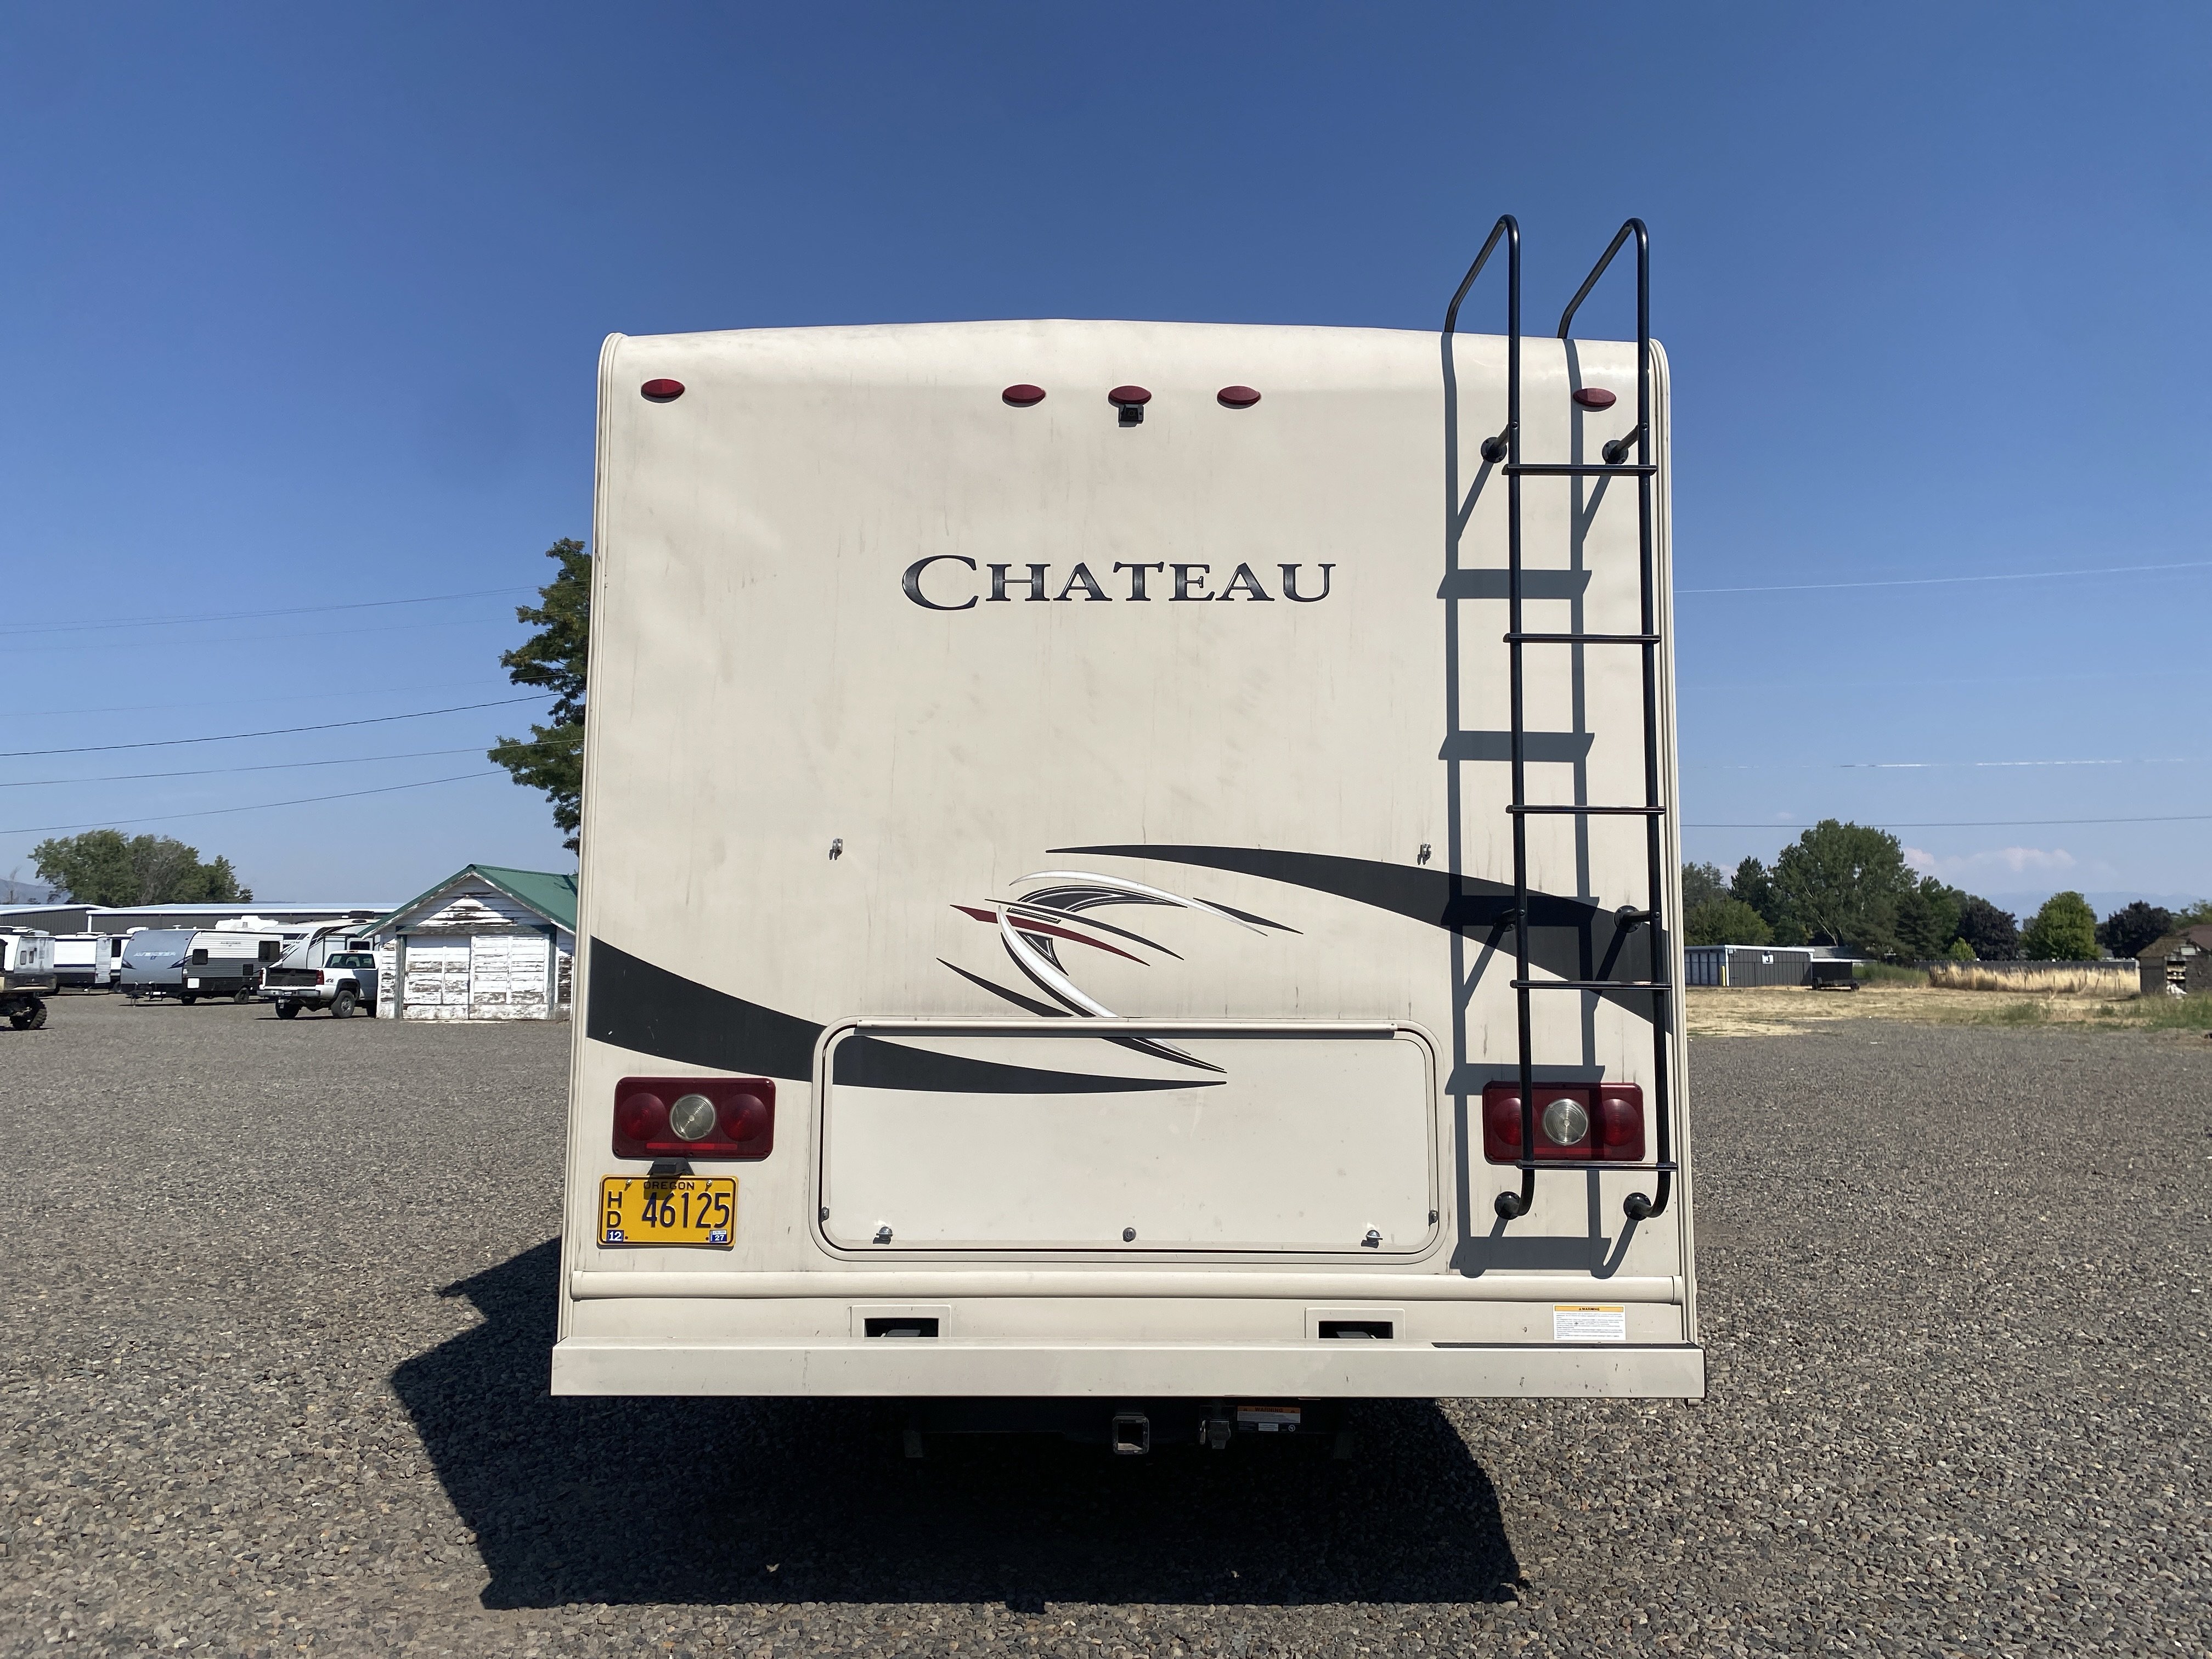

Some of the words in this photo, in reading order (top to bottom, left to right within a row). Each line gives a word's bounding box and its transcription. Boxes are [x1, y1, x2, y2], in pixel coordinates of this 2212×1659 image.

[901, 554, 1336, 611] CHATEAU
[643, 1181, 695, 1190] OREGON
[642, 1192, 731, 1228] 46125
[608, 1231, 622, 1241] 12
